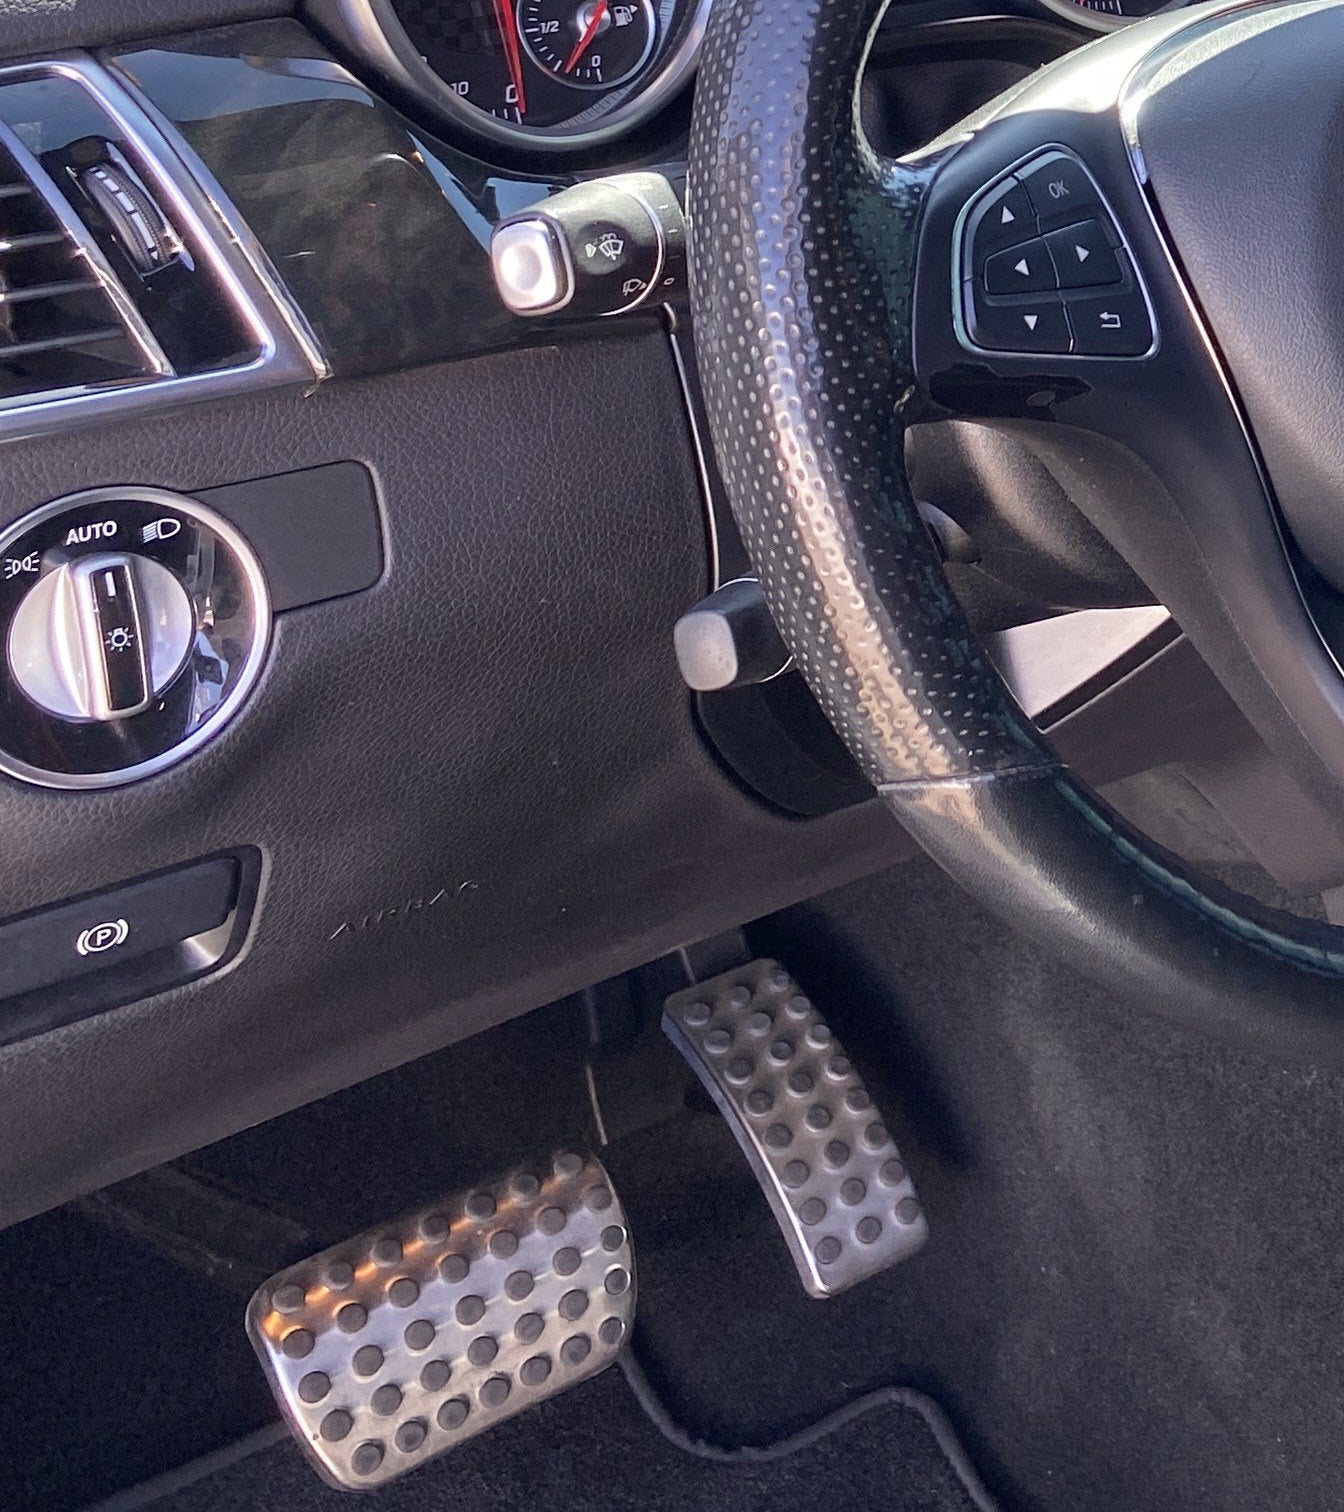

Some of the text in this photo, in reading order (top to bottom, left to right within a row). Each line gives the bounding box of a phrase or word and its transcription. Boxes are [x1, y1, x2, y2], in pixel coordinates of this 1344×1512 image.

[540, 20, 560, 34] 1/2
[591, 55, 601, 68] 0
[1048, 179, 1070, 199] OK
[65, 520, 118, 545] AUTO
